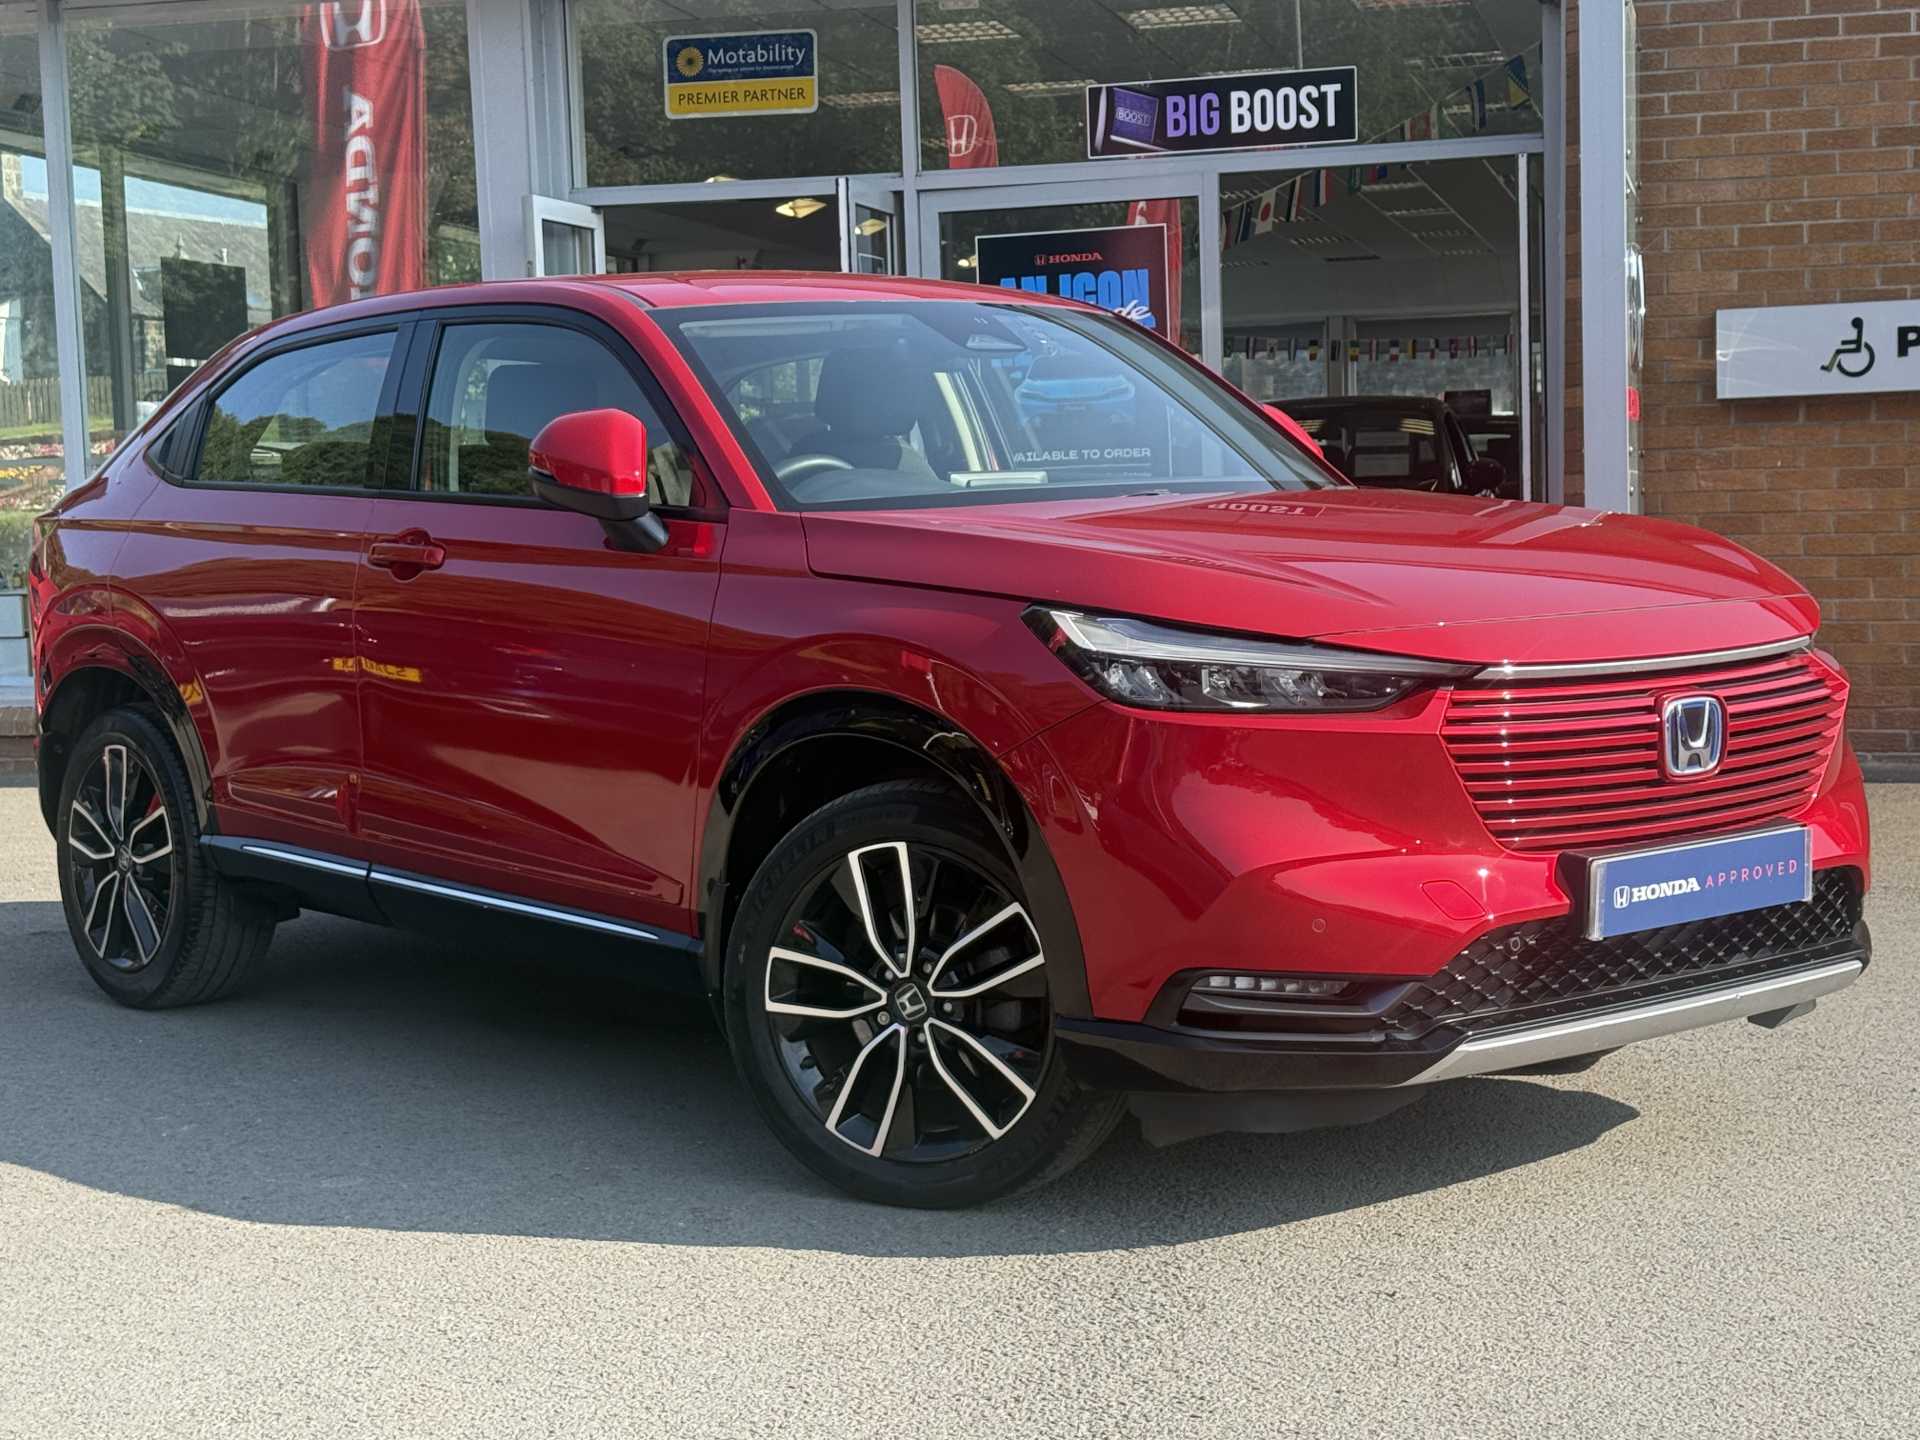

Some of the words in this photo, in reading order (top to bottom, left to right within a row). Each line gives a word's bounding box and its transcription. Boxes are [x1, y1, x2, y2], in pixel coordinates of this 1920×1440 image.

[708, 44, 806, 65] Motability
[678, 91, 740, 106] PREMIER
[743, 87, 806, 102] PARTNER
[1117, 108, 1150, 126] BOOST
[1166, 92, 1220, 138] BIG
[1230, 83, 1342, 134] BOOST
[1048, 252, 1103, 264] HONDA
[1082, 449, 1099, 460] TO
[1103, 447, 1151, 459] ORDER
[1631, 877, 1700, 902] HONDA
[1705, 859, 1797, 888] APPROVED
